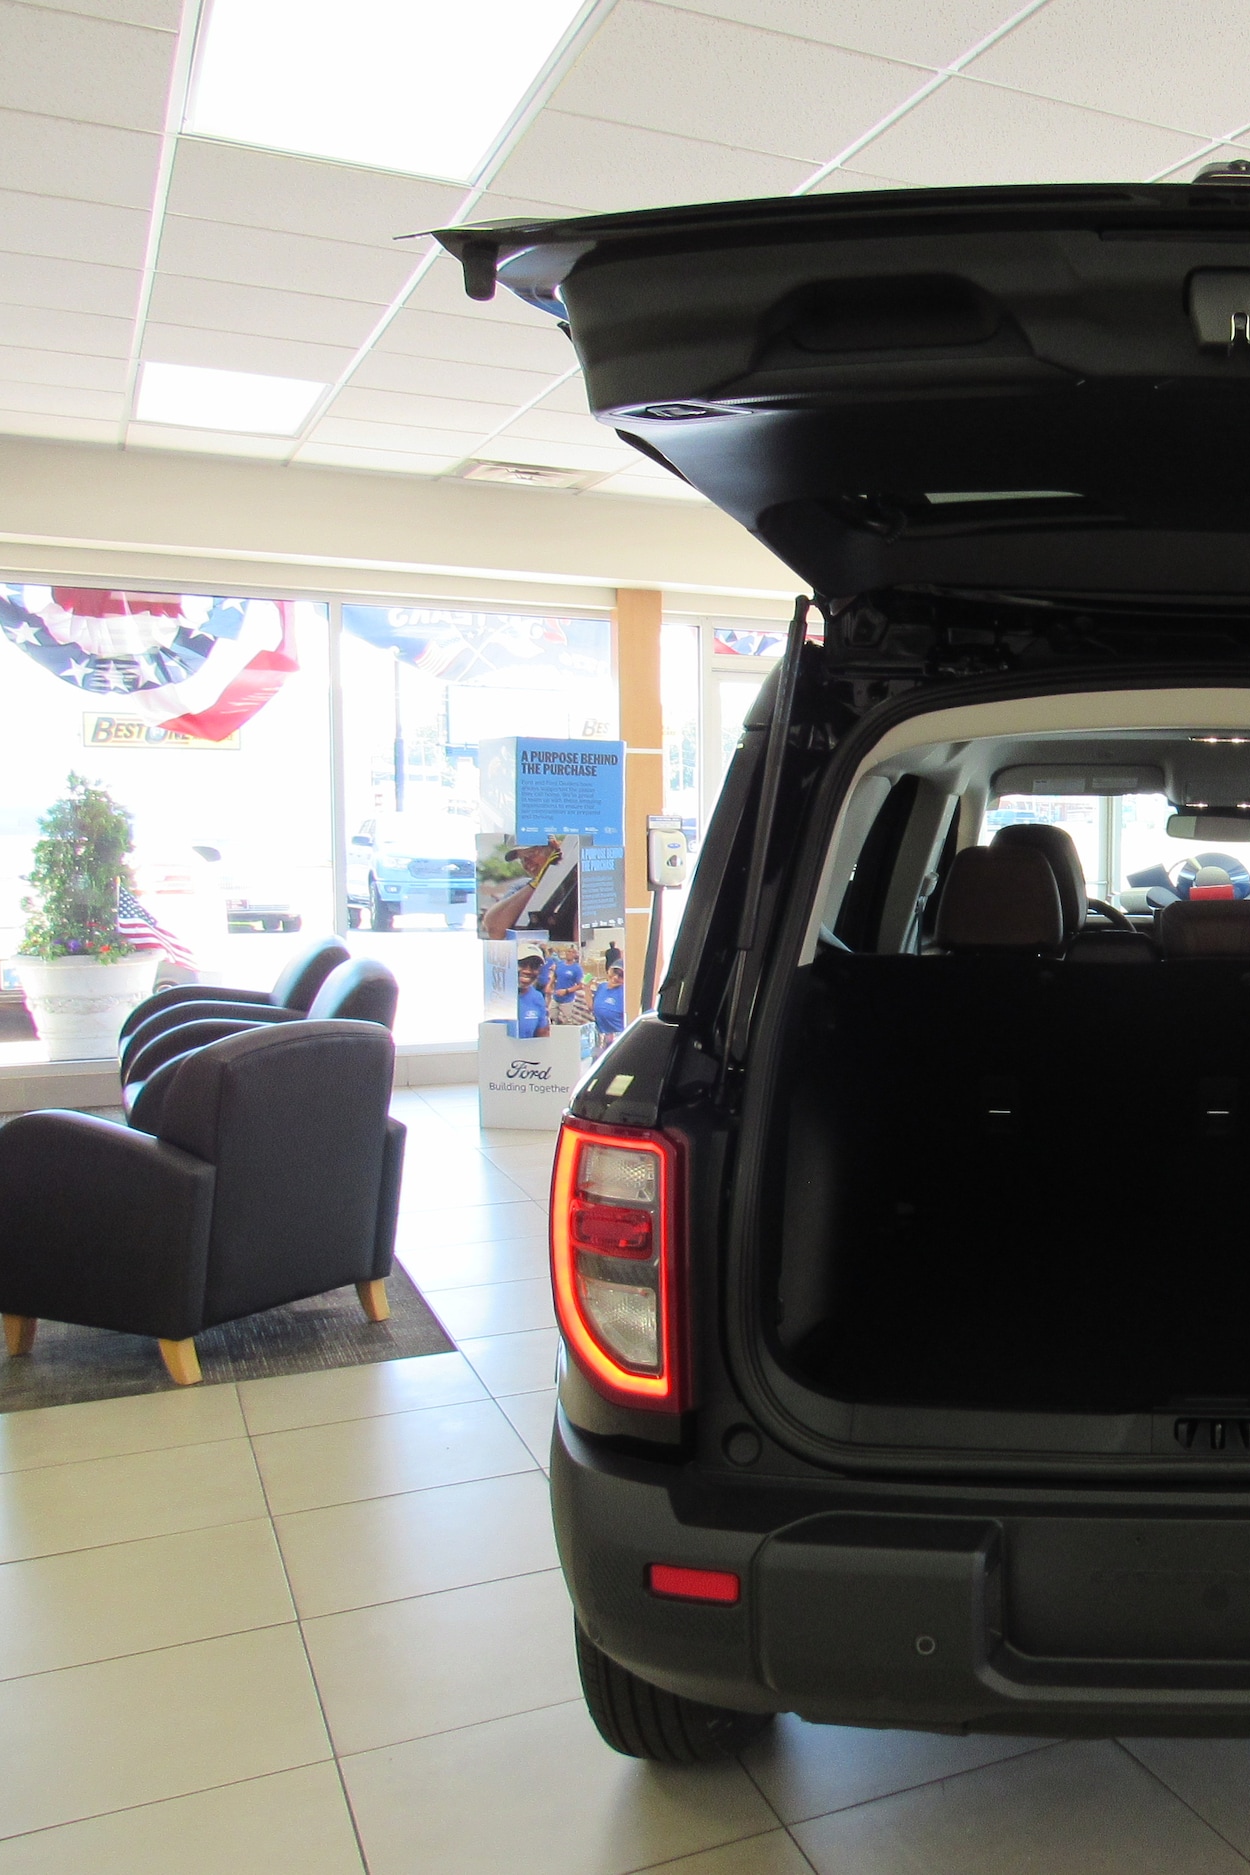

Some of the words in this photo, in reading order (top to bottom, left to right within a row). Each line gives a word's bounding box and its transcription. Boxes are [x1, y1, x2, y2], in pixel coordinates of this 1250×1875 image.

[582, 719, 610, 737] BES
[521, 751, 529, 762] A
[531, 751, 578, 764] PURPOSE
[581, 753, 618, 765] BEHIND
[521, 763, 541, 775] THE
[543, 764, 597, 776] PURCHASE
[581, 860, 591, 872] THE
[591, 859, 615, 871] PURCHASE
[506, 1060, 552, 1080] Ford
[489, 1082, 527, 1093] Building
[530, 1083, 570, 1094] Together
